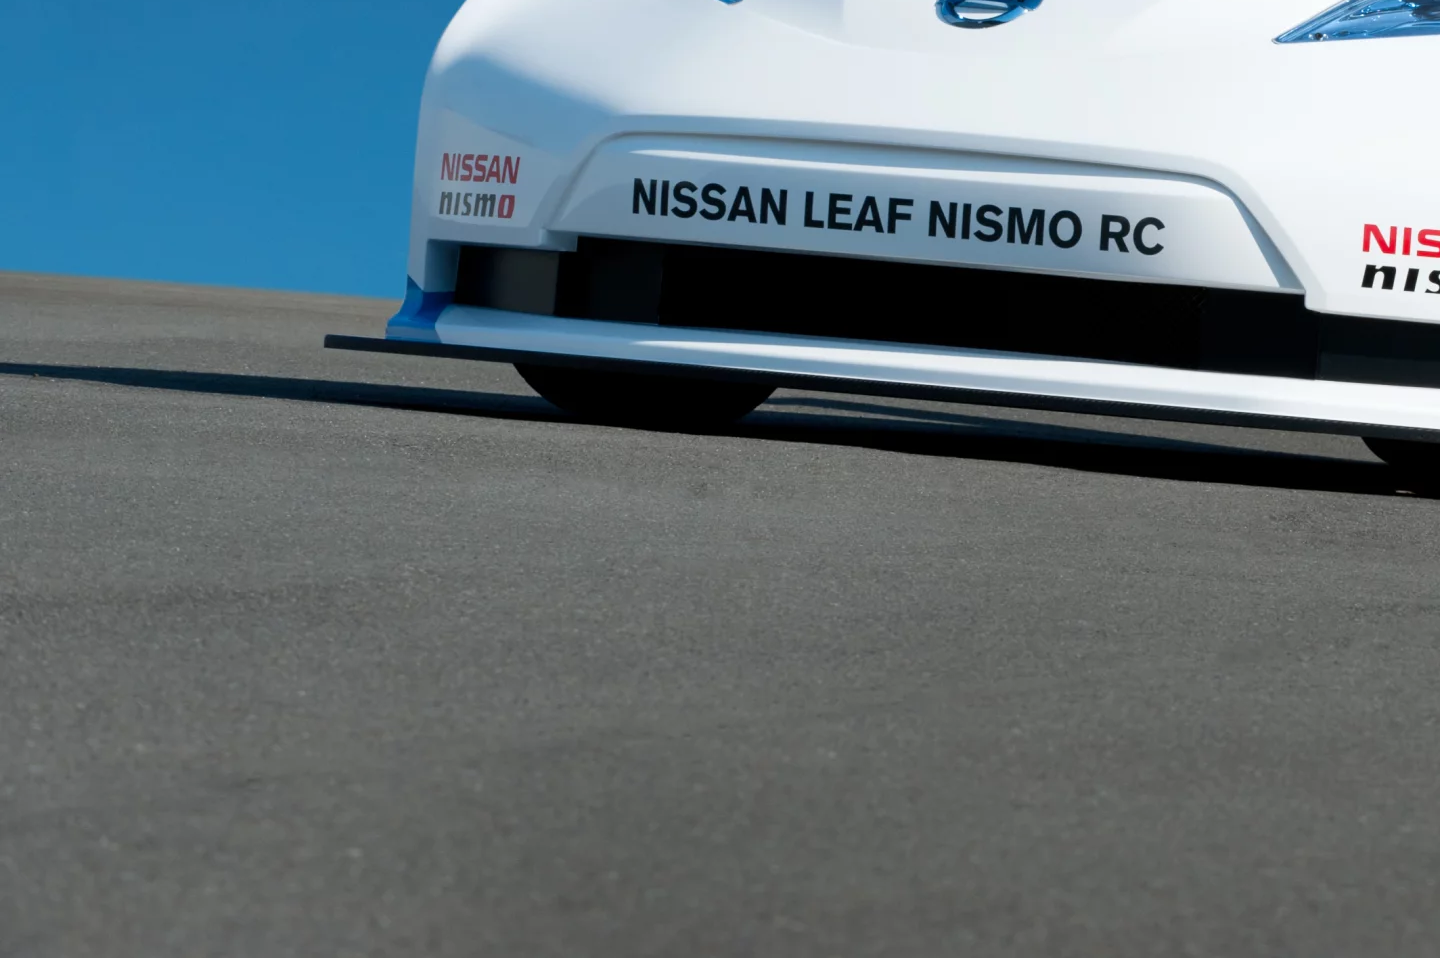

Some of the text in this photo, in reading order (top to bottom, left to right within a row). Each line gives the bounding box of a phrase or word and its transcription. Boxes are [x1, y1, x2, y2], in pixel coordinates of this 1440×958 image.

[440, 152, 521, 185] NISSAN
[438, 190, 516, 220] nismo
[632, 178, 1166, 256] NISSAN LEAF NISMO RC
